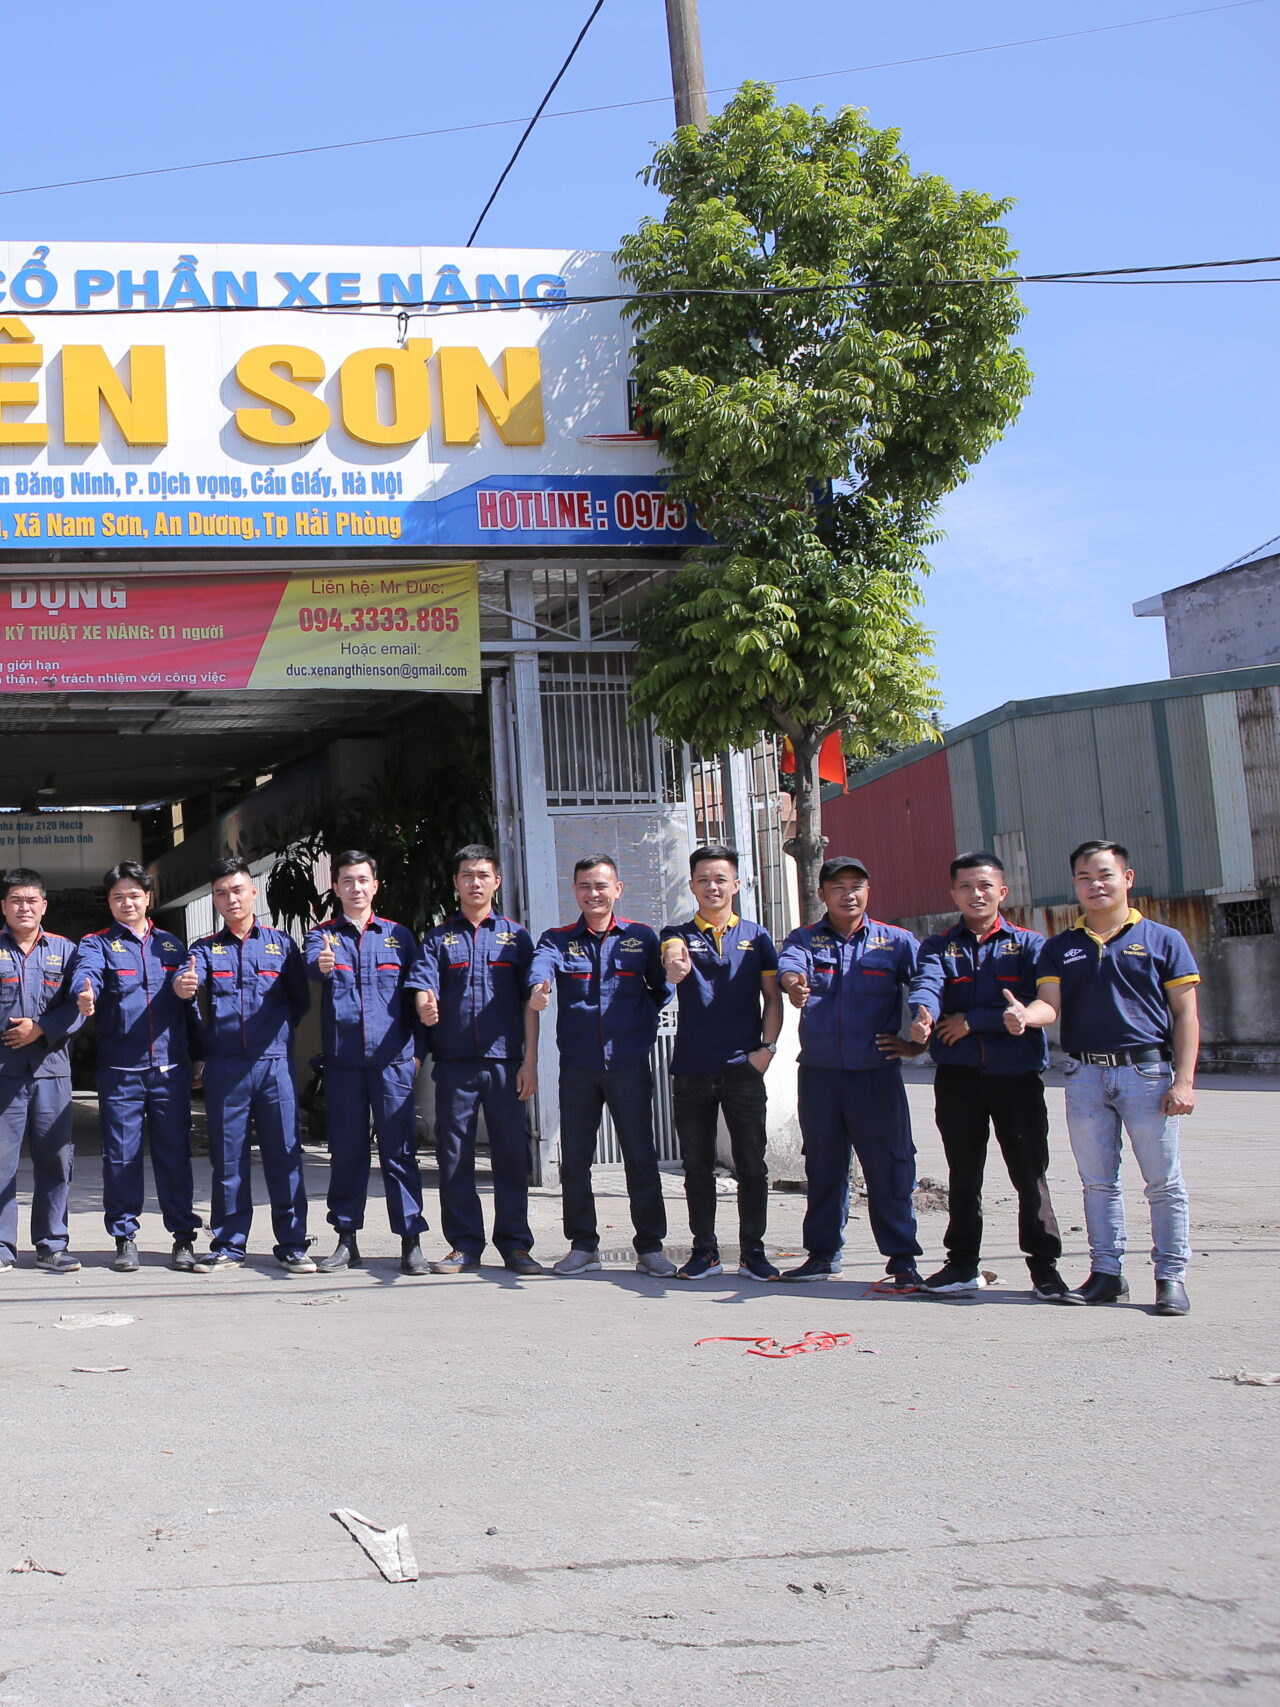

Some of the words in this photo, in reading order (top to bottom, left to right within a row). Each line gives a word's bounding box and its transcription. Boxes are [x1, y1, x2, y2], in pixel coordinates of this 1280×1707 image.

[75, 254, 258, 310] PHẦN
[266, 272, 361, 309] XE
[378, 265, 569, 311] NÂNG
[234, 337, 546, 448] SƠN
[16, 471, 64, 499] Đăng
[70, 471, 121, 498] Ninh,
[125, 471, 144, 496] P.
[148, 470, 191, 500] Dịch
[196, 471, 248, 499] vọng,
[250, 467, 287, 496] Cầu
[342, 471, 367, 496] Hà
[372, 470, 403, 500] Nội
[13, 511, 41, 538] Xã
[47, 512, 96, 538] Nam
[101, 511, 149, 540] Sơn,
[154, 511, 183, 537] An
[187, 511, 261, 540] Dương,
[261, 511, 289, 539] Tp
[295, 507, 330, 537] Hải
[335, 510, 402, 540] Phòng
[614, 490, 688, 531] 0975
[10, 580, 128, 616] DỤNG
[311, 579, 345, 595] Liên
[350, 579, 375, 597] hệ:
[380, 579, 401, 594] Mr
[406, 578, 444, 595] Đức:
[5, 623, 26, 641] KỸ
[29, 622, 78, 644] THUẬT
[81, 625, 101, 640] XE
[106, 622, 155, 640] NÂNG:
[158, 625, 176, 640] 01
[181, 624, 225, 642] người
[298, 606, 460, 633] 094.3333.885
[340, 642, 377, 658] Hoặc
[380, 642, 421, 655] email:
[6, 674, 38, 687] thận,
[42, 674, 58, 685] có
[61, 673, 94, 683] trách
[97, 673, 137, 685] nhiệm
[140, 672, 161, 683] với
[165, 672, 197, 685] công
[200, 671, 227, 683] việc
[7, 660, 32, 672] giới
[36, 660, 60, 672] hạn
[286, 663, 467, 680] duc.xenangthienson@gmail.com
